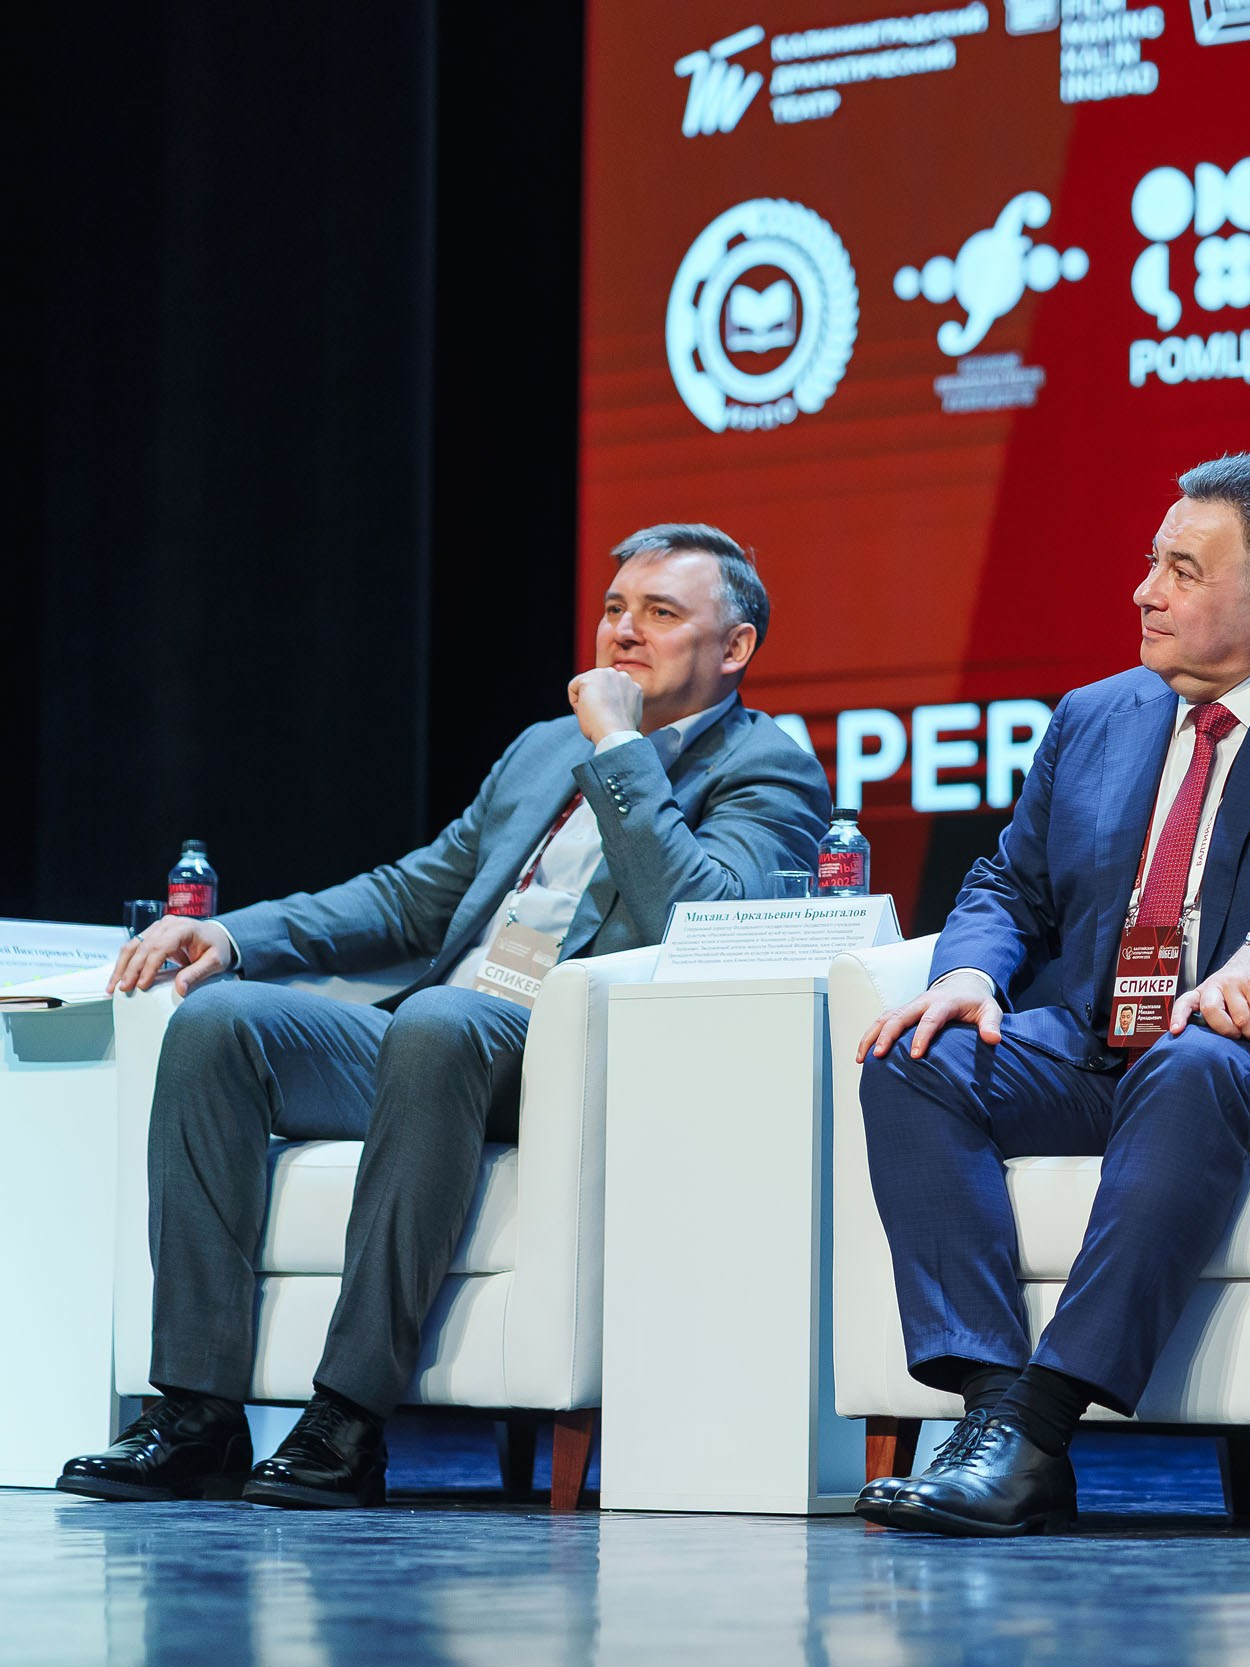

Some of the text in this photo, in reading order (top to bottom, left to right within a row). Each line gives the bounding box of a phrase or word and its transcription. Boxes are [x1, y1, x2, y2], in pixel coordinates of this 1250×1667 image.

[685, 907, 868, 923] Михаил Аркадьевич Брызгалов
[485, 966, 541, 994] СПИКЕР
[1119, 979, 1174, 993] СПИКЕР
